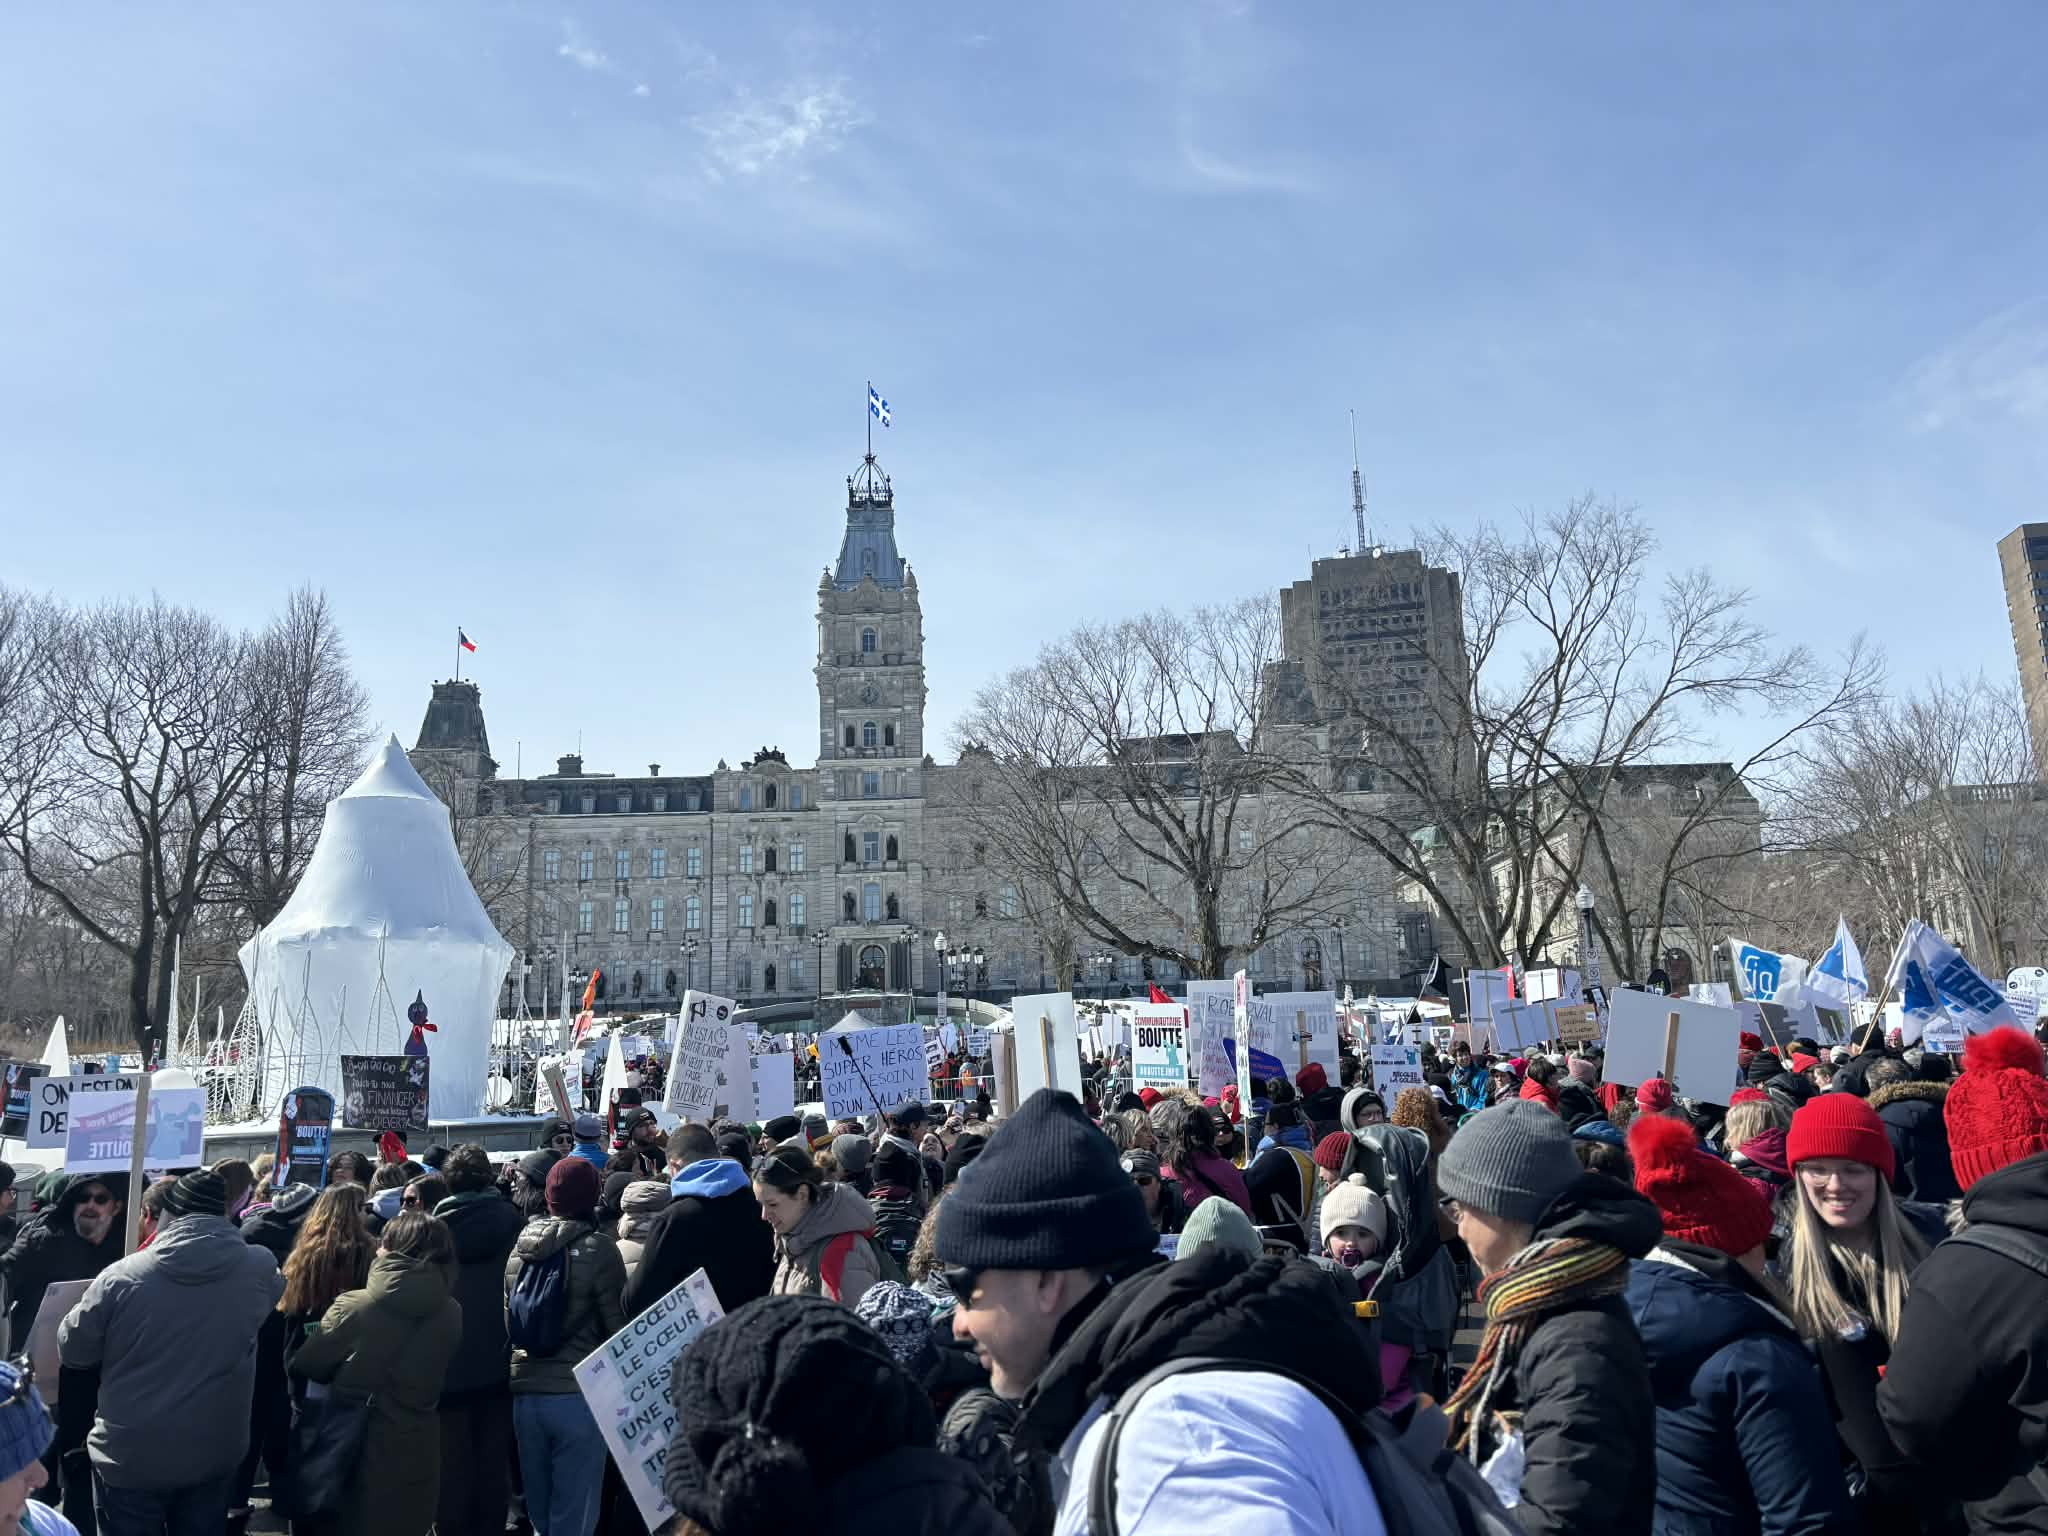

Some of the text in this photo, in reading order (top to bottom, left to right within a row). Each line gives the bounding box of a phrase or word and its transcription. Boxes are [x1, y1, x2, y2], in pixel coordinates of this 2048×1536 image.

[829, 1028, 918, 1057] MME LES
[823, 1056, 873, 1080] SUPER
[828, 1078, 856, 1097] ONT
[832, 1096, 863, 1117] D'UN
[611, 1334, 635, 1358] LE
[622, 1353, 644, 1379] LE
[623, 1401, 662, 1441] UNE
